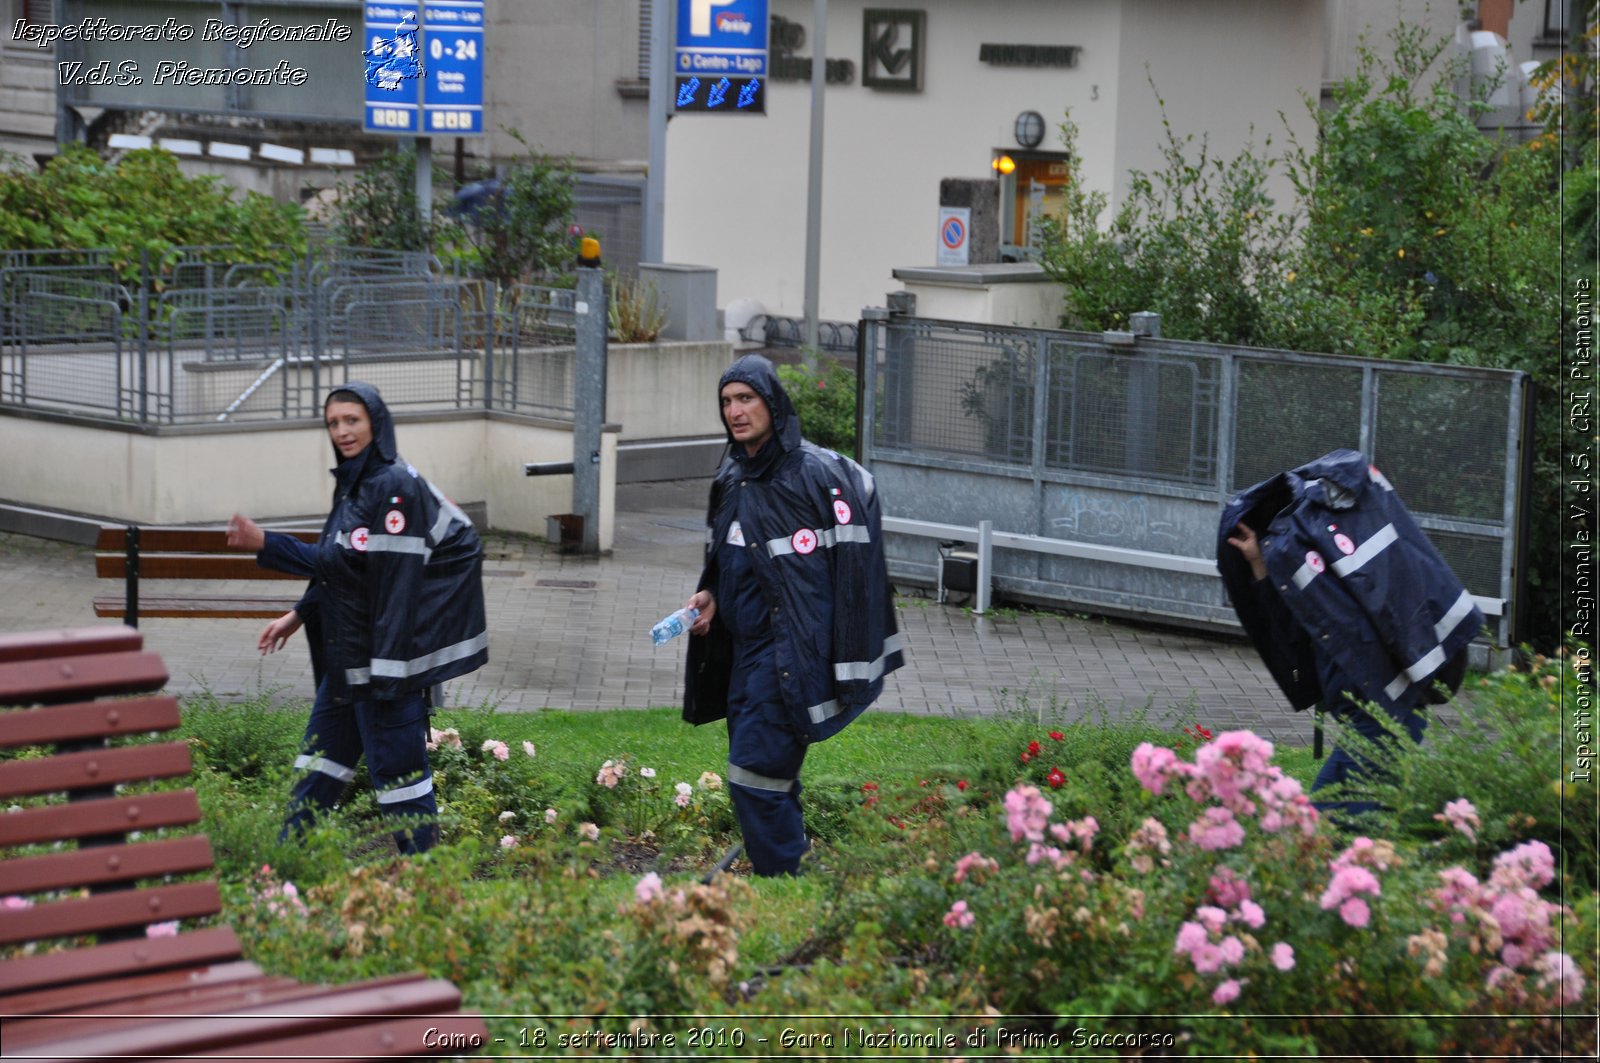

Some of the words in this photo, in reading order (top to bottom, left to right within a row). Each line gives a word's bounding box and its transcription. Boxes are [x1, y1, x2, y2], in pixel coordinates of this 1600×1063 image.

[431, 38, 442, 60] 0
[455, 39, 477, 60] 24
[693, 54, 728, 70] Centro
[736, 55, 762, 72] Lago
